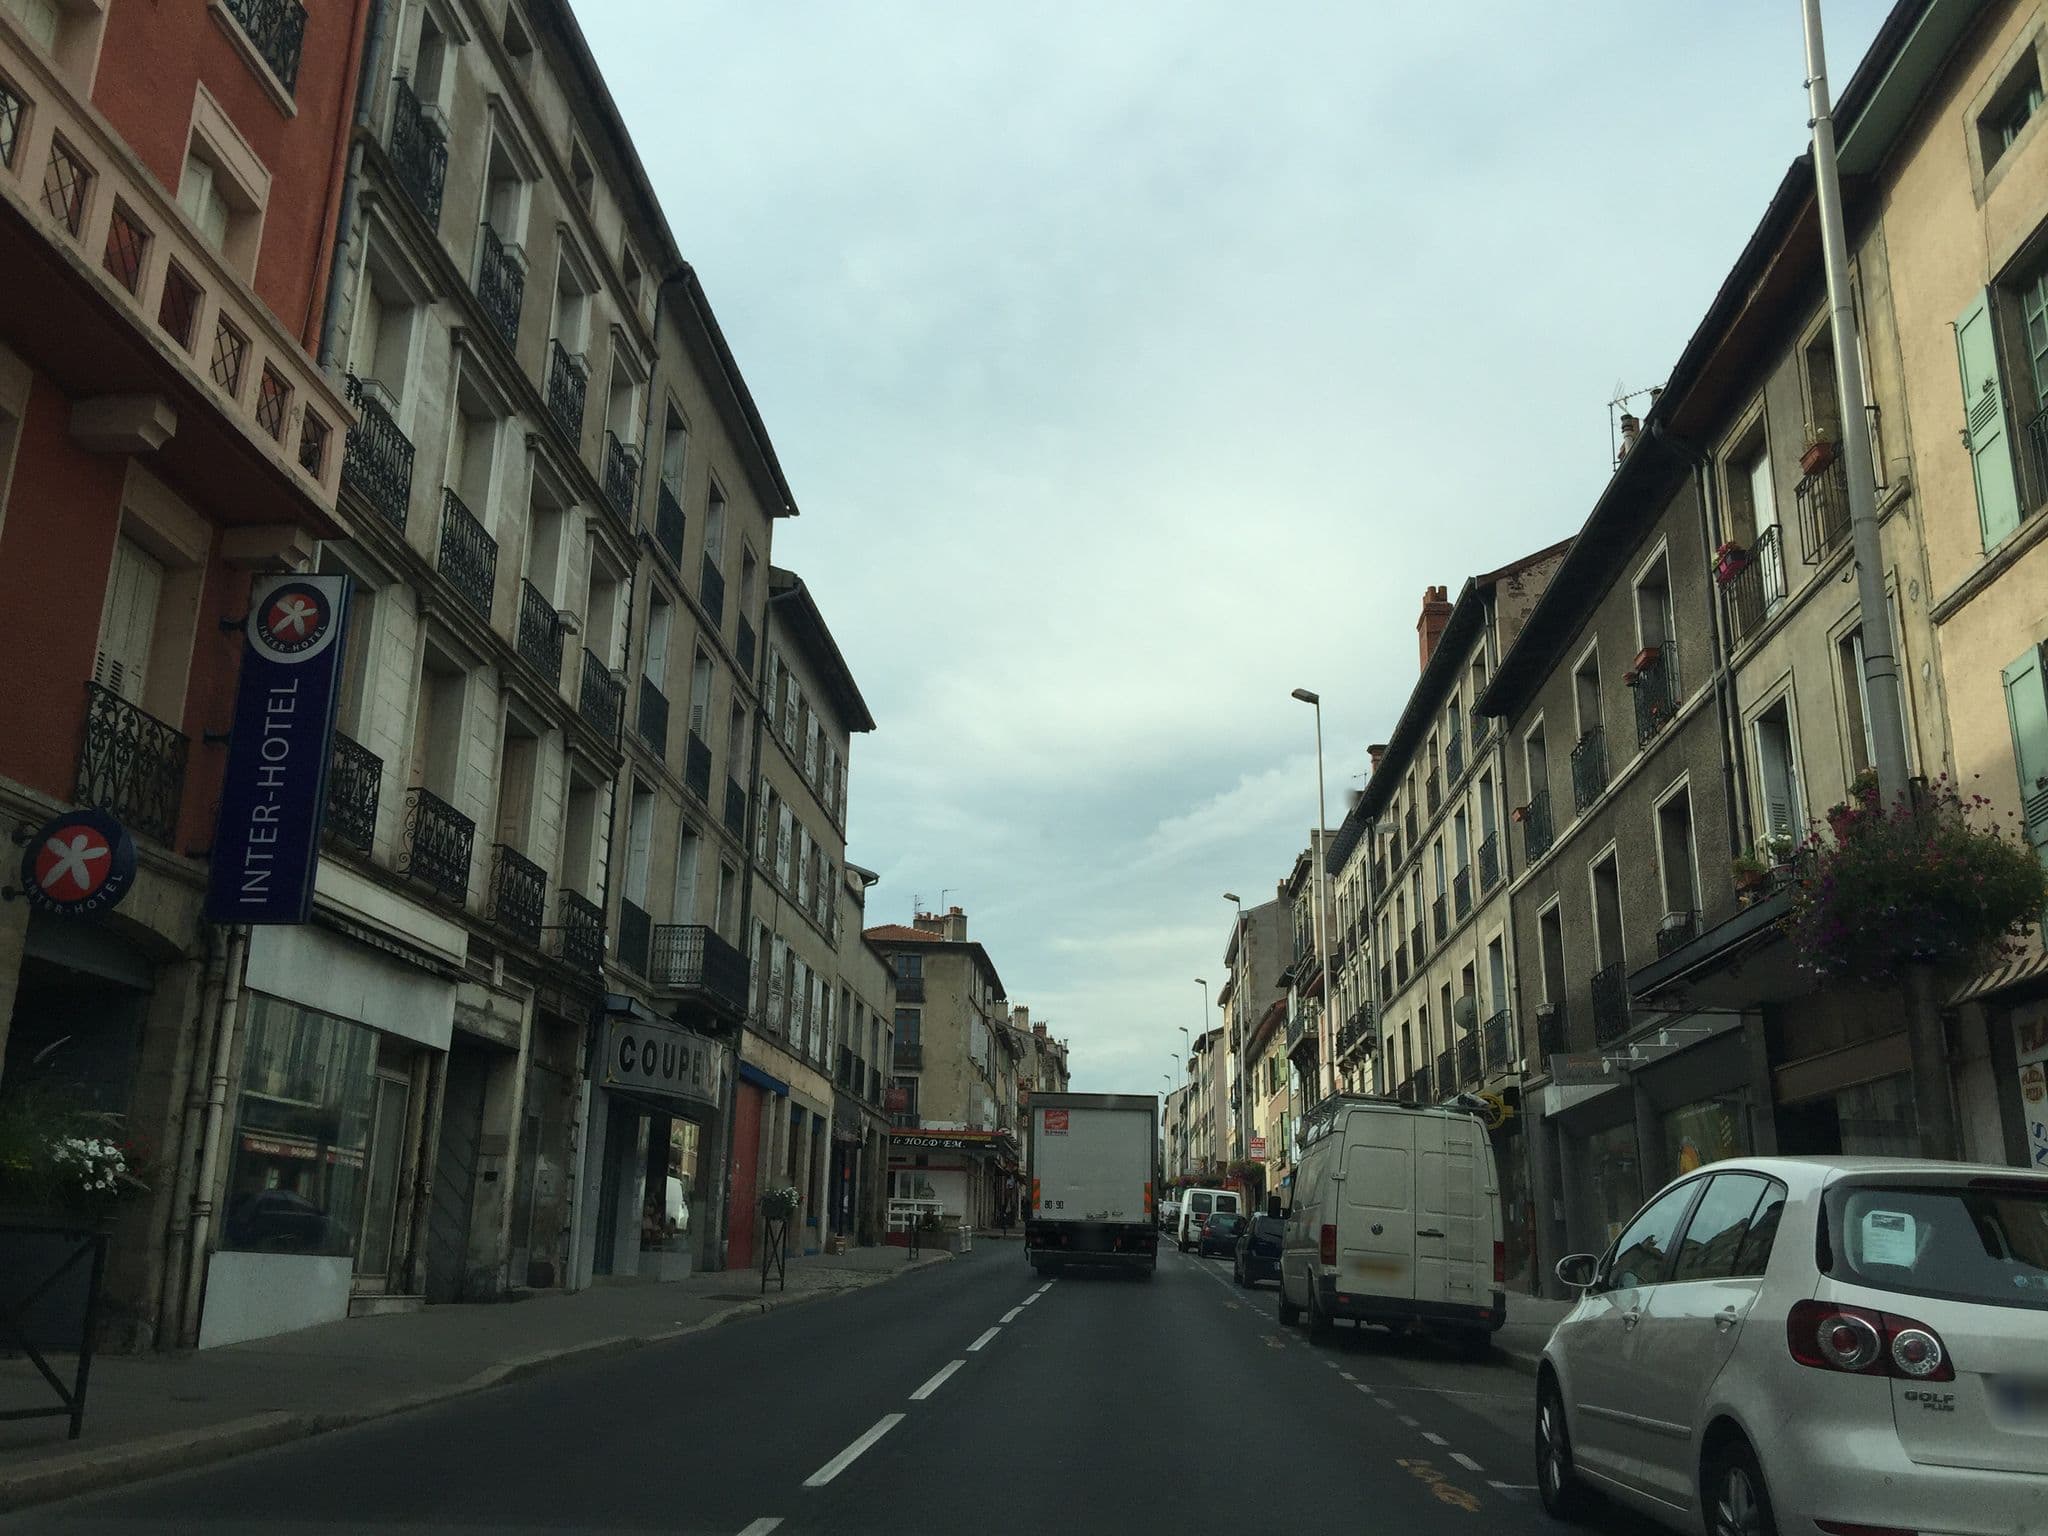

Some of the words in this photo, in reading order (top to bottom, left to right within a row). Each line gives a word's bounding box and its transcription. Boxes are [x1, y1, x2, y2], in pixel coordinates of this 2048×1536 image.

[257, 624, 327, 653] INTER-HOTEL
[239, 677, 299, 904] INTER-HOTEL
[25, 873, 124, 914] INTER-HOTEL
[1904, 1391, 1954, 1404] GOLF
[1923, 1403, 1955, 1412] PLUS
